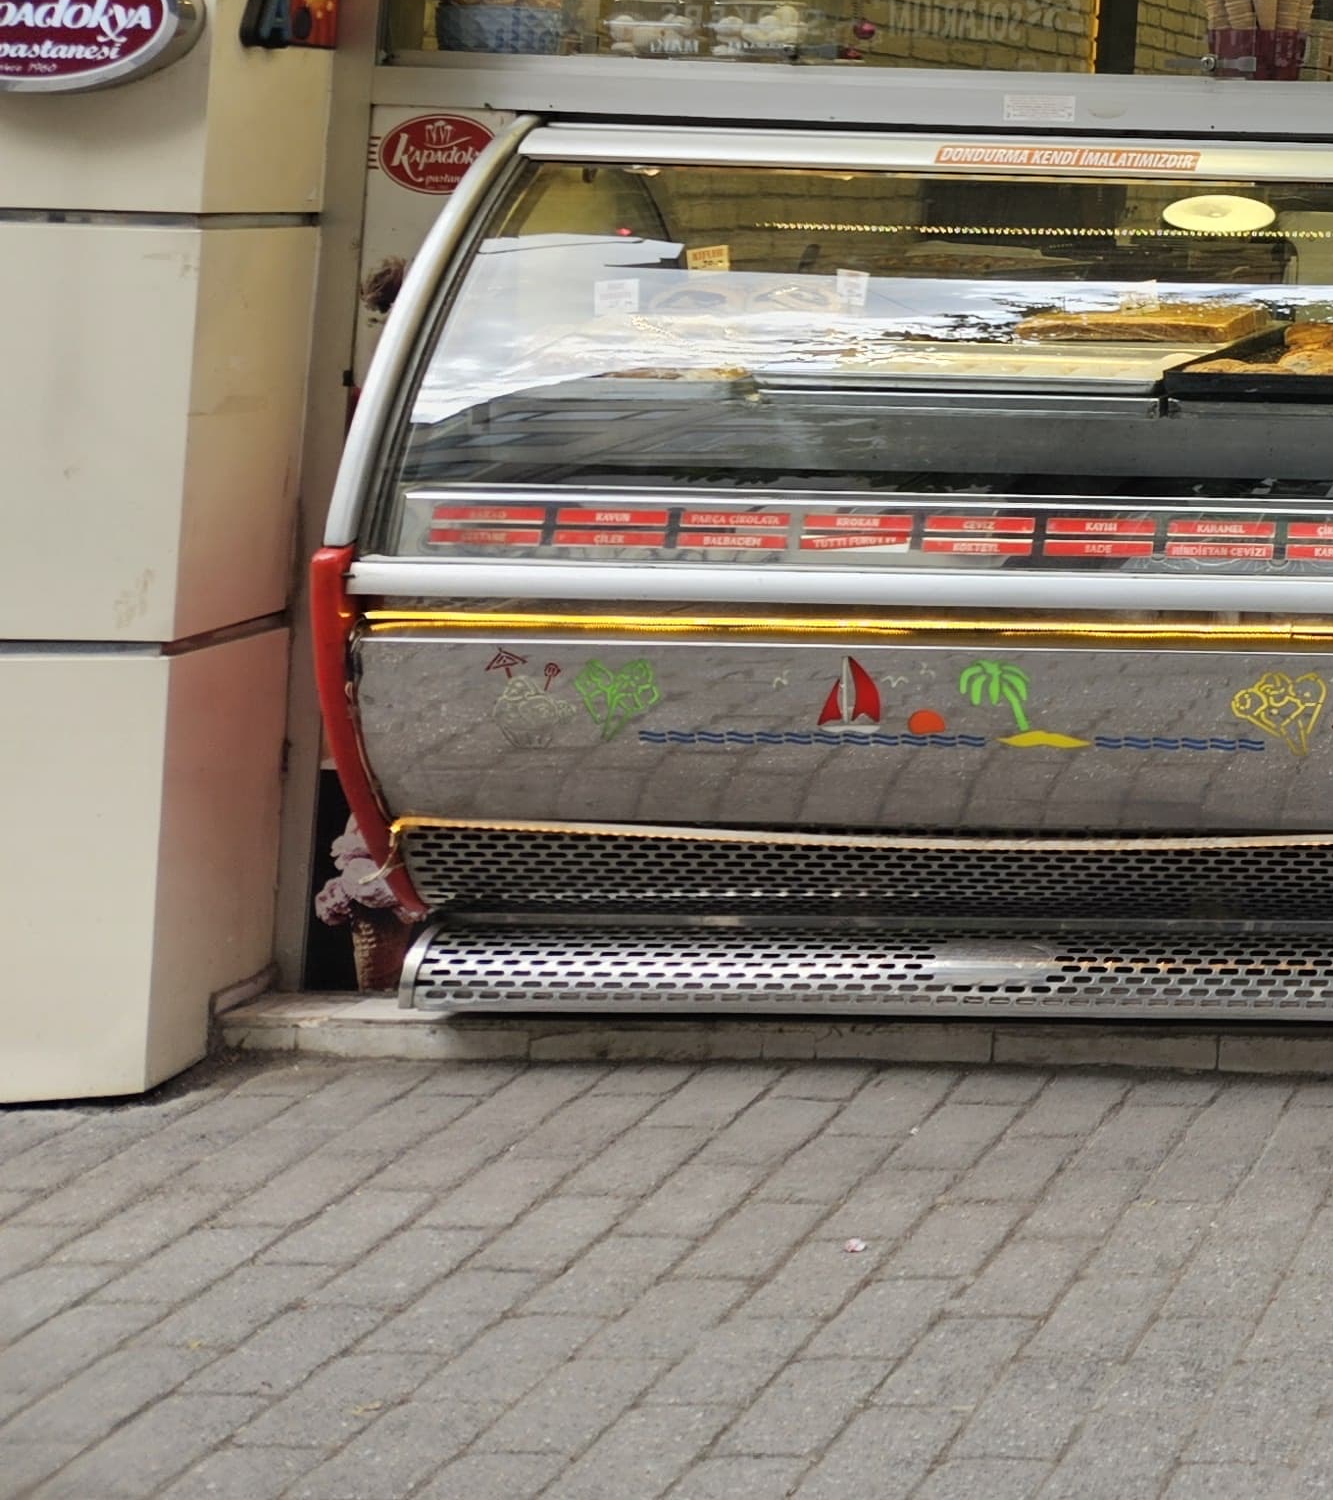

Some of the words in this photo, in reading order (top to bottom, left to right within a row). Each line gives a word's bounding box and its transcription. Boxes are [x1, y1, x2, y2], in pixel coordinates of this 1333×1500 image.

[939, 146, 1028, 164] DONDURMA
[1031, 148, 1080, 166] KENDİ
[595, 512, 631, 522] KAVUN
[1197, 524, 1246, 534] KARAMEL
